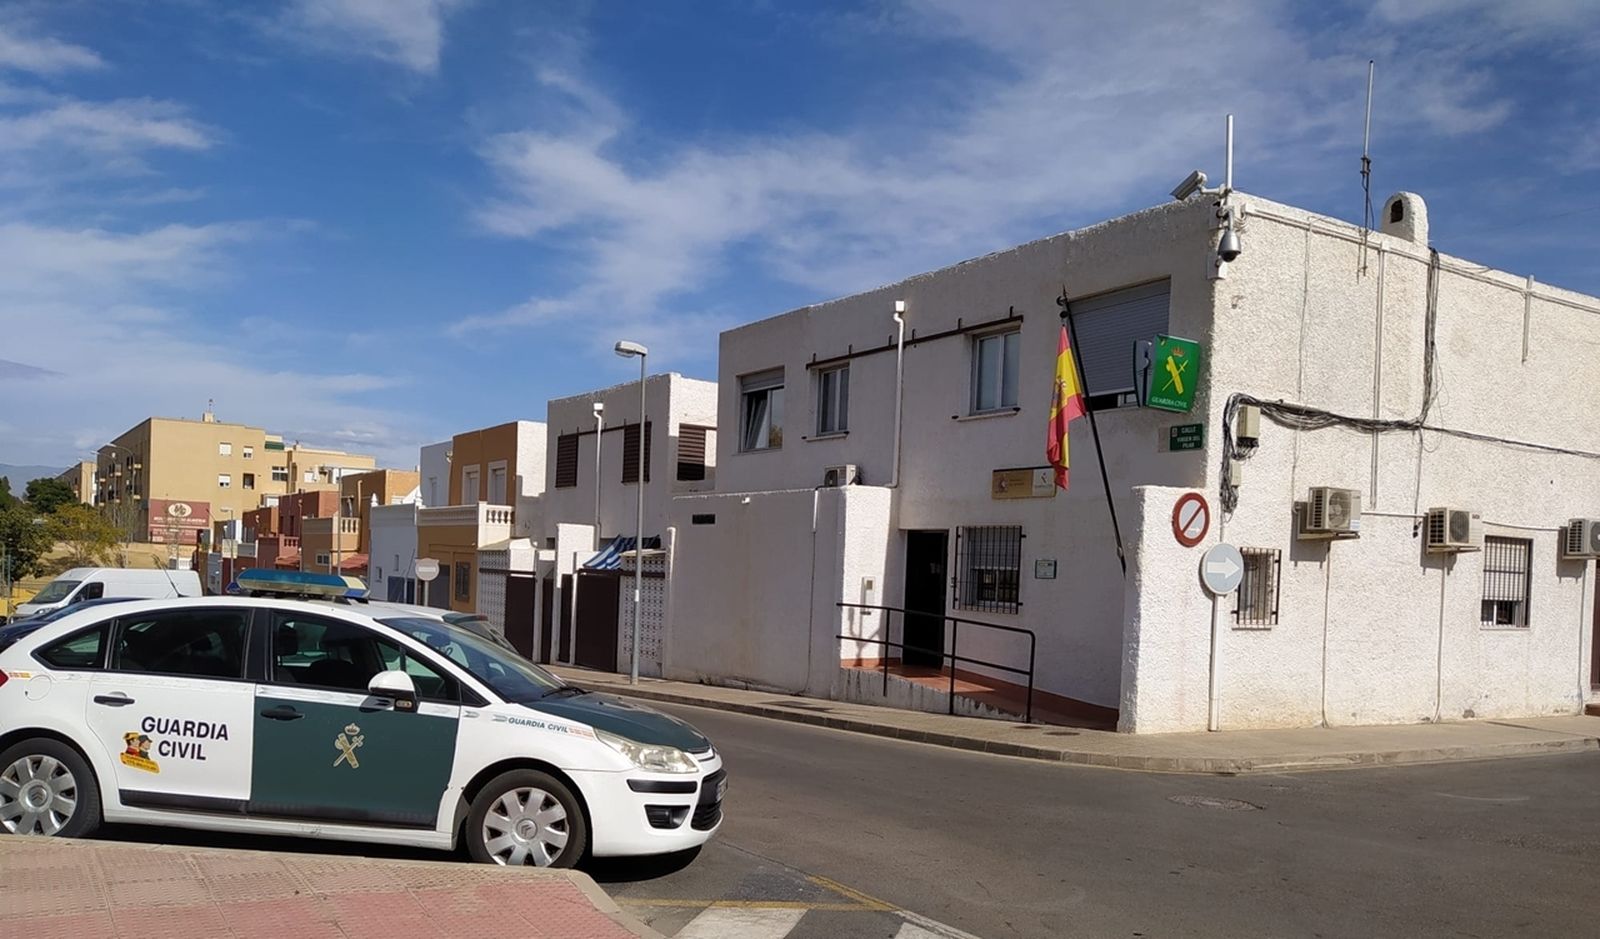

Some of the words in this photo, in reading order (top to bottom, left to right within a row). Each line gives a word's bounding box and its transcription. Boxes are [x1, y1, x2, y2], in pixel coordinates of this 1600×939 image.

[141, 716, 229, 741] GUARDIA
[508, 718, 545, 728] GUARDIA
[547, 723, 568, 733] CIVIL
[158, 740, 207, 761] CIVIL
